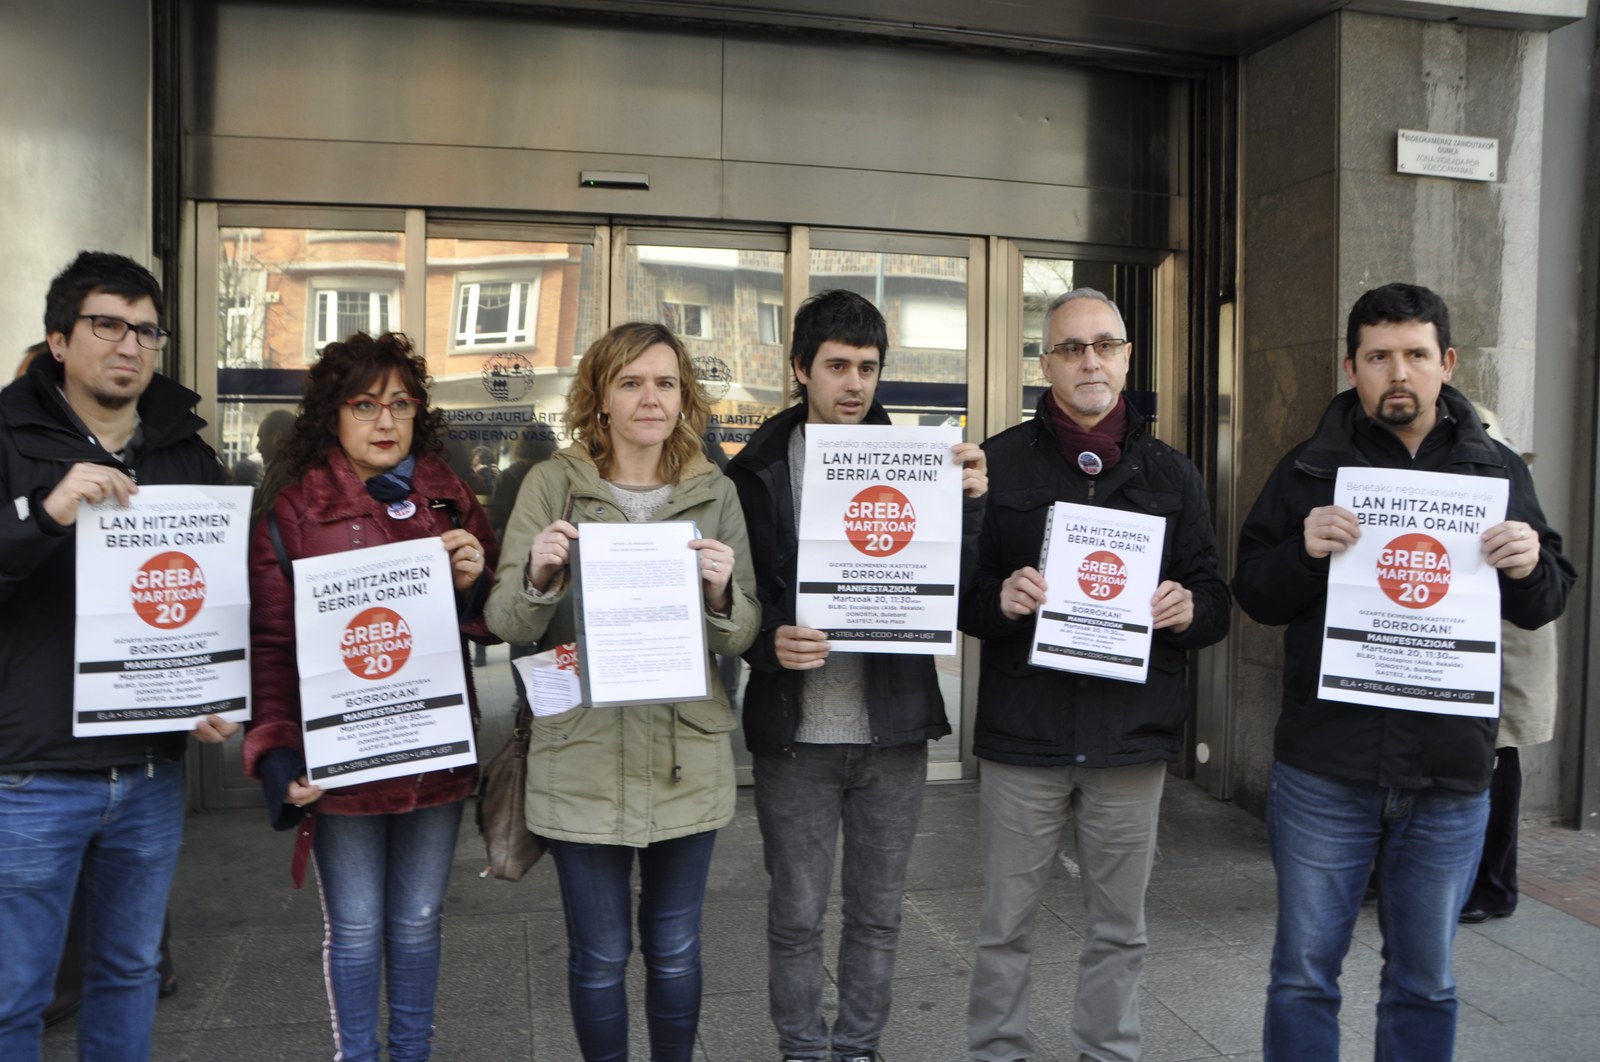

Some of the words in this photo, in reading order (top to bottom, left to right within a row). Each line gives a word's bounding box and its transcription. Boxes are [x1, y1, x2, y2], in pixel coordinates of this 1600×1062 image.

[1416, 154, 1435, 162] ZONA
[488, 411, 567, 423] JAURLARITZ
[448, 430, 519, 441] GOBIERNO
[522, 431, 565, 441] VASCO
[719, 433, 752, 443] VASC
[817, 439, 860, 449] Benetako
[861, 440, 928, 450] negoziazioaren
[823, 453, 852, 465] LAN
[858, 453, 943, 466] HITZARMEN
[827, 469, 880, 481] BERRIA
[885, 470, 938, 481] ORAIN!
[1347, 481, 1392, 493] Benetako
[1395, 485, 1469, 499] negoziazioaren
[846, 502, 915, 519] GREBA
[1353, 496, 1386, 510] LAN
[1391, 498, 1486, 519] HITZARMEN
[100, 516, 137, 530] LAN
[143, 514, 231, 530] HITZARMEN
[844, 521, 916, 533] MARTXOAK
[1358, 513, 1418, 529] BERRIA
[1424, 517, 1480, 534] ORAIN!
[106, 534, 169, 548] BERRIA
[174, 531, 226, 546] ORAIN!
[1066, 523, 1087, 534] LAN
[1090, 526, 1150, 543] HITZARMEN
[865, 534, 893, 551] 20
[1068, 534, 1106, 548] BERRIA
[1110, 540, 1146, 554] ORAIN!
[1378, 548, 1451, 571] GREBA
[842, 570, 914, 580] BORROKAN!
[1080, 560, 1127, 577] GREBA
[1376, 568, 1452, 585] MARTXOAK
[134, 567, 206, 589] GREBA
[313, 581, 343, 599] LAN
[346, 566, 431, 593] HITZARMEN
[1078, 572, 1127, 586] MARTXOAK
[131, 587, 207, 604] MARTXOAK
[837, 585, 918, 593] MANIFESTAZIOAK
[1089, 583, 1111, 598] 20
[1398, 583, 1430, 603] 20
[318, 594, 371, 613] BERRIA
[375, 583, 429, 602] ORAIN!
[875, 596, 888, 604] 20,
[155, 603, 186, 624] 20
[1072, 606, 1122, 619] BORROKAN!
[1359, 609, 1385, 617] GIZARTE
[1067, 615, 1125, 629] MANIFESTAZIOAK
[1373, 619, 1452, 635] BORROKAN!
[341, 619, 411, 646] GREBA
[129, 640, 208, 656] BORROKAN!
[340, 639, 414, 659] MARTXOAK
[1367, 633, 1456, 649] MANIFESTAZIOAK
[1361, 644, 1404, 655] Martxoak
[1407, 650, 1423, 658] 20,
[123, 655, 213, 671] MANIFESTAZIOAK
[363, 654, 393, 676] 20
[118, 672, 164, 681] Martxoak
[345, 687, 420, 708] BORROKAN!
[1340, 679, 1357, 688] ELA
[1363, 682, 1396, 693] STEILAS
[1402, 687, 1427, 696] CCOO
[1434, 690, 1452, 699] LAB
[1458, 692, 1476, 700] UGT
[342, 702, 427, 723] MANIFESTAZIOAK
[340, 720, 381, 734] Martxoak
[327, 764, 345, 775] ELA
[350, 758, 381, 770] STEILAS
[386, 753, 410, 764] CCOO
[415, 749, 431, 759] LAB
[436, 745, 453, 755] UGT
